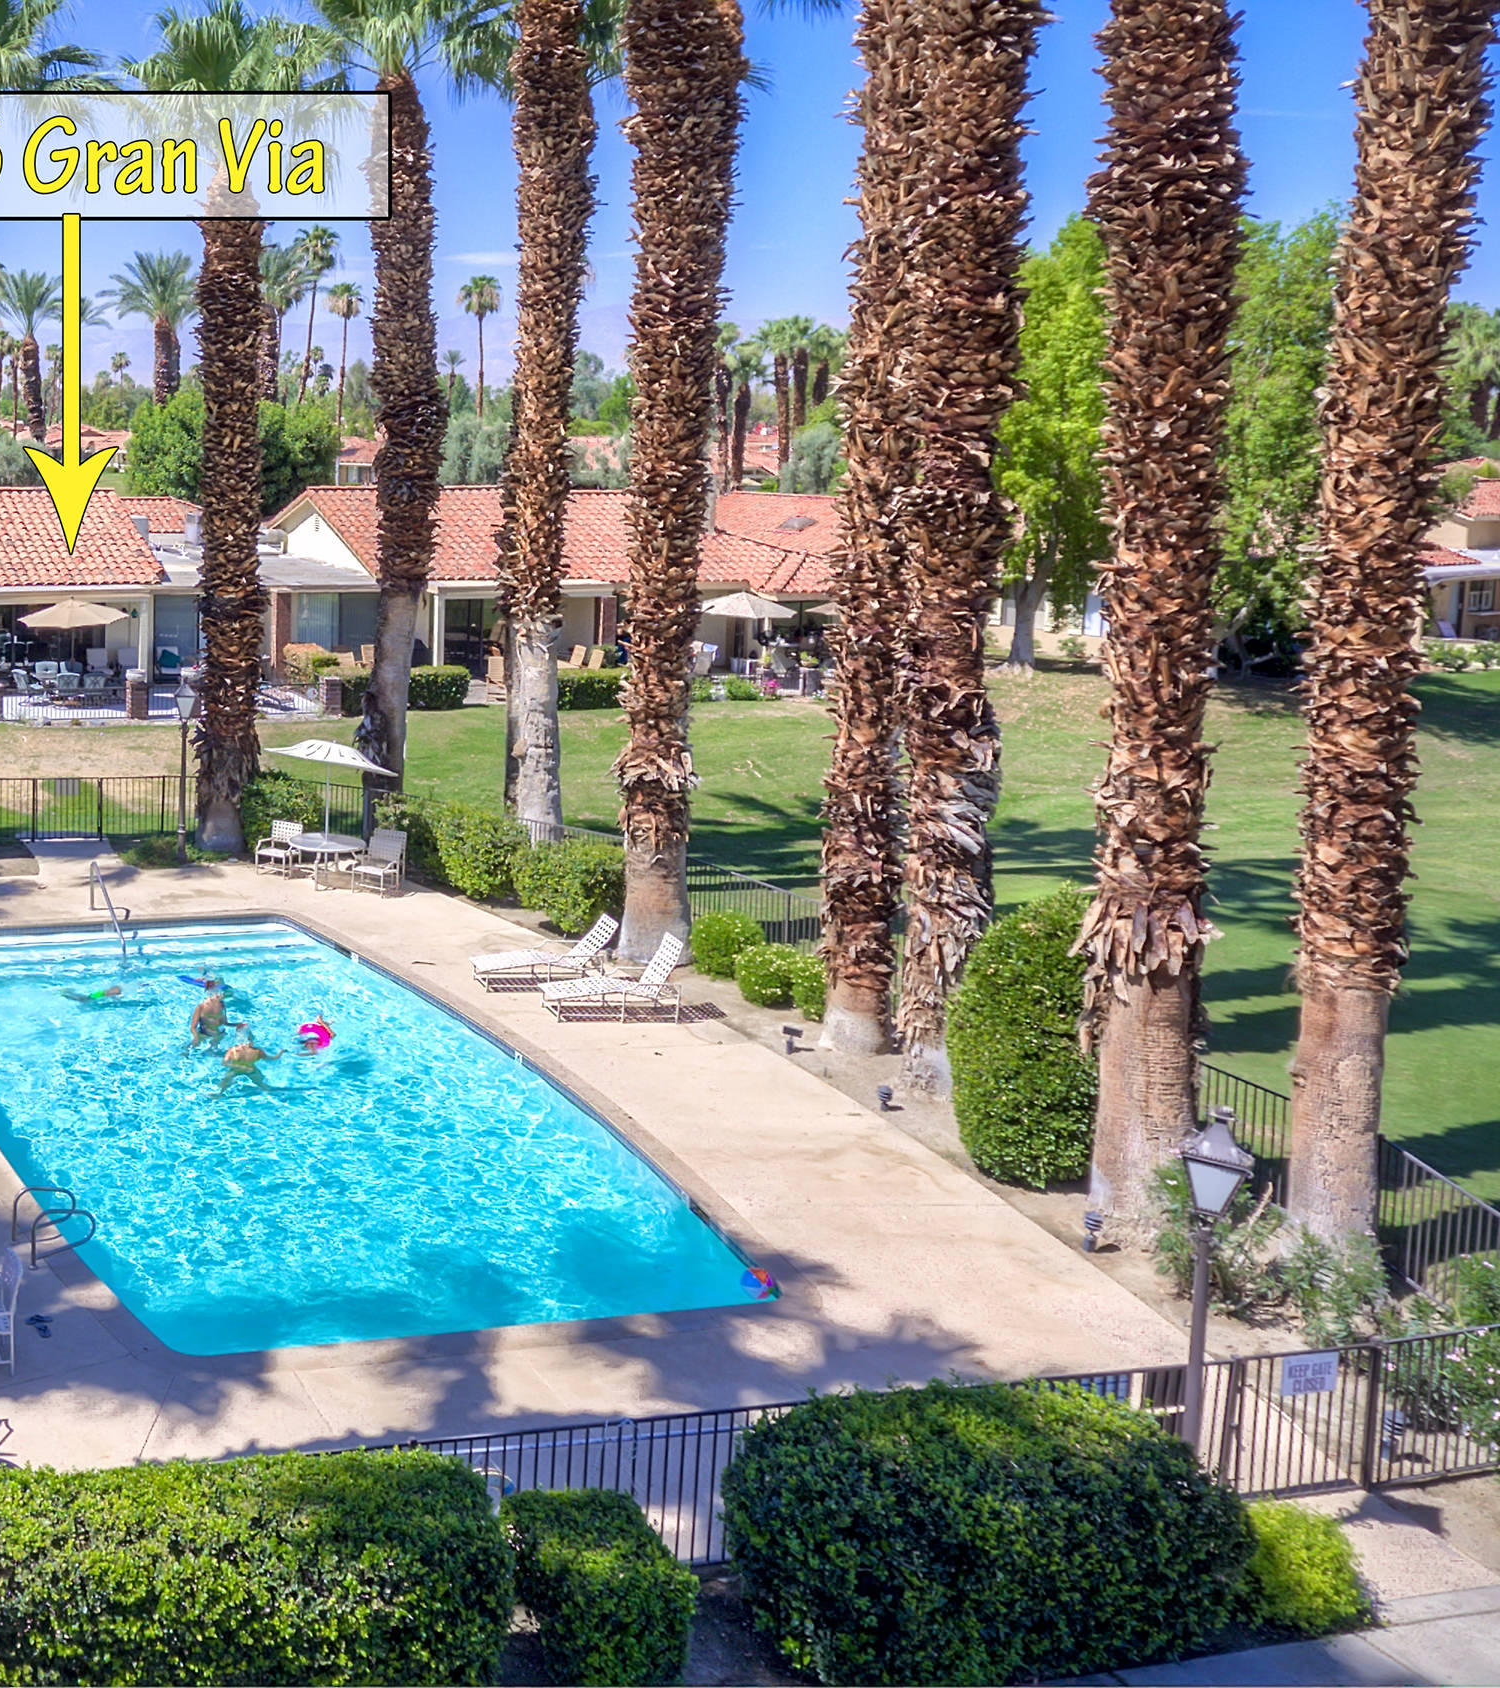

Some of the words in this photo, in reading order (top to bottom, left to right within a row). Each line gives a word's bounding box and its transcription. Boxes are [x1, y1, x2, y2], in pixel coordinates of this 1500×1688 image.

[1288, 1364, 1310, 1378] KEEP
[1311, 1361, 1333, 1376] GATE
[1292, 1376, 1325, 1393] CLOSED
